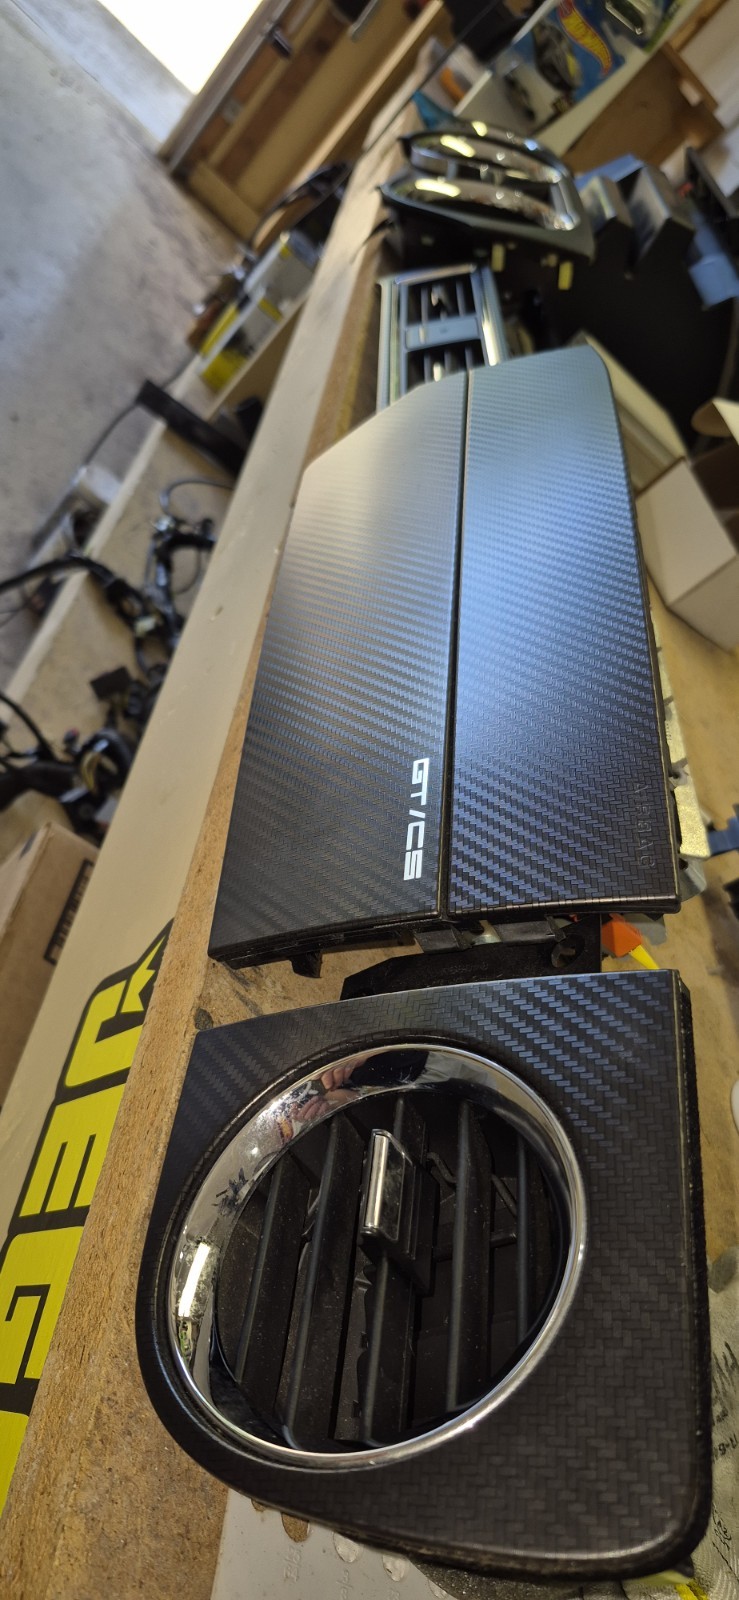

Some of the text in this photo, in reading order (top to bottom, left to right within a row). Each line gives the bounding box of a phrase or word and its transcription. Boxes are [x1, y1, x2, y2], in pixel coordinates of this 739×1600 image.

[403, 757, 430, 881] GT/CS
[634, 781, 656, 870] AIRBAG
[0, 937, 166, 1518] JEG
